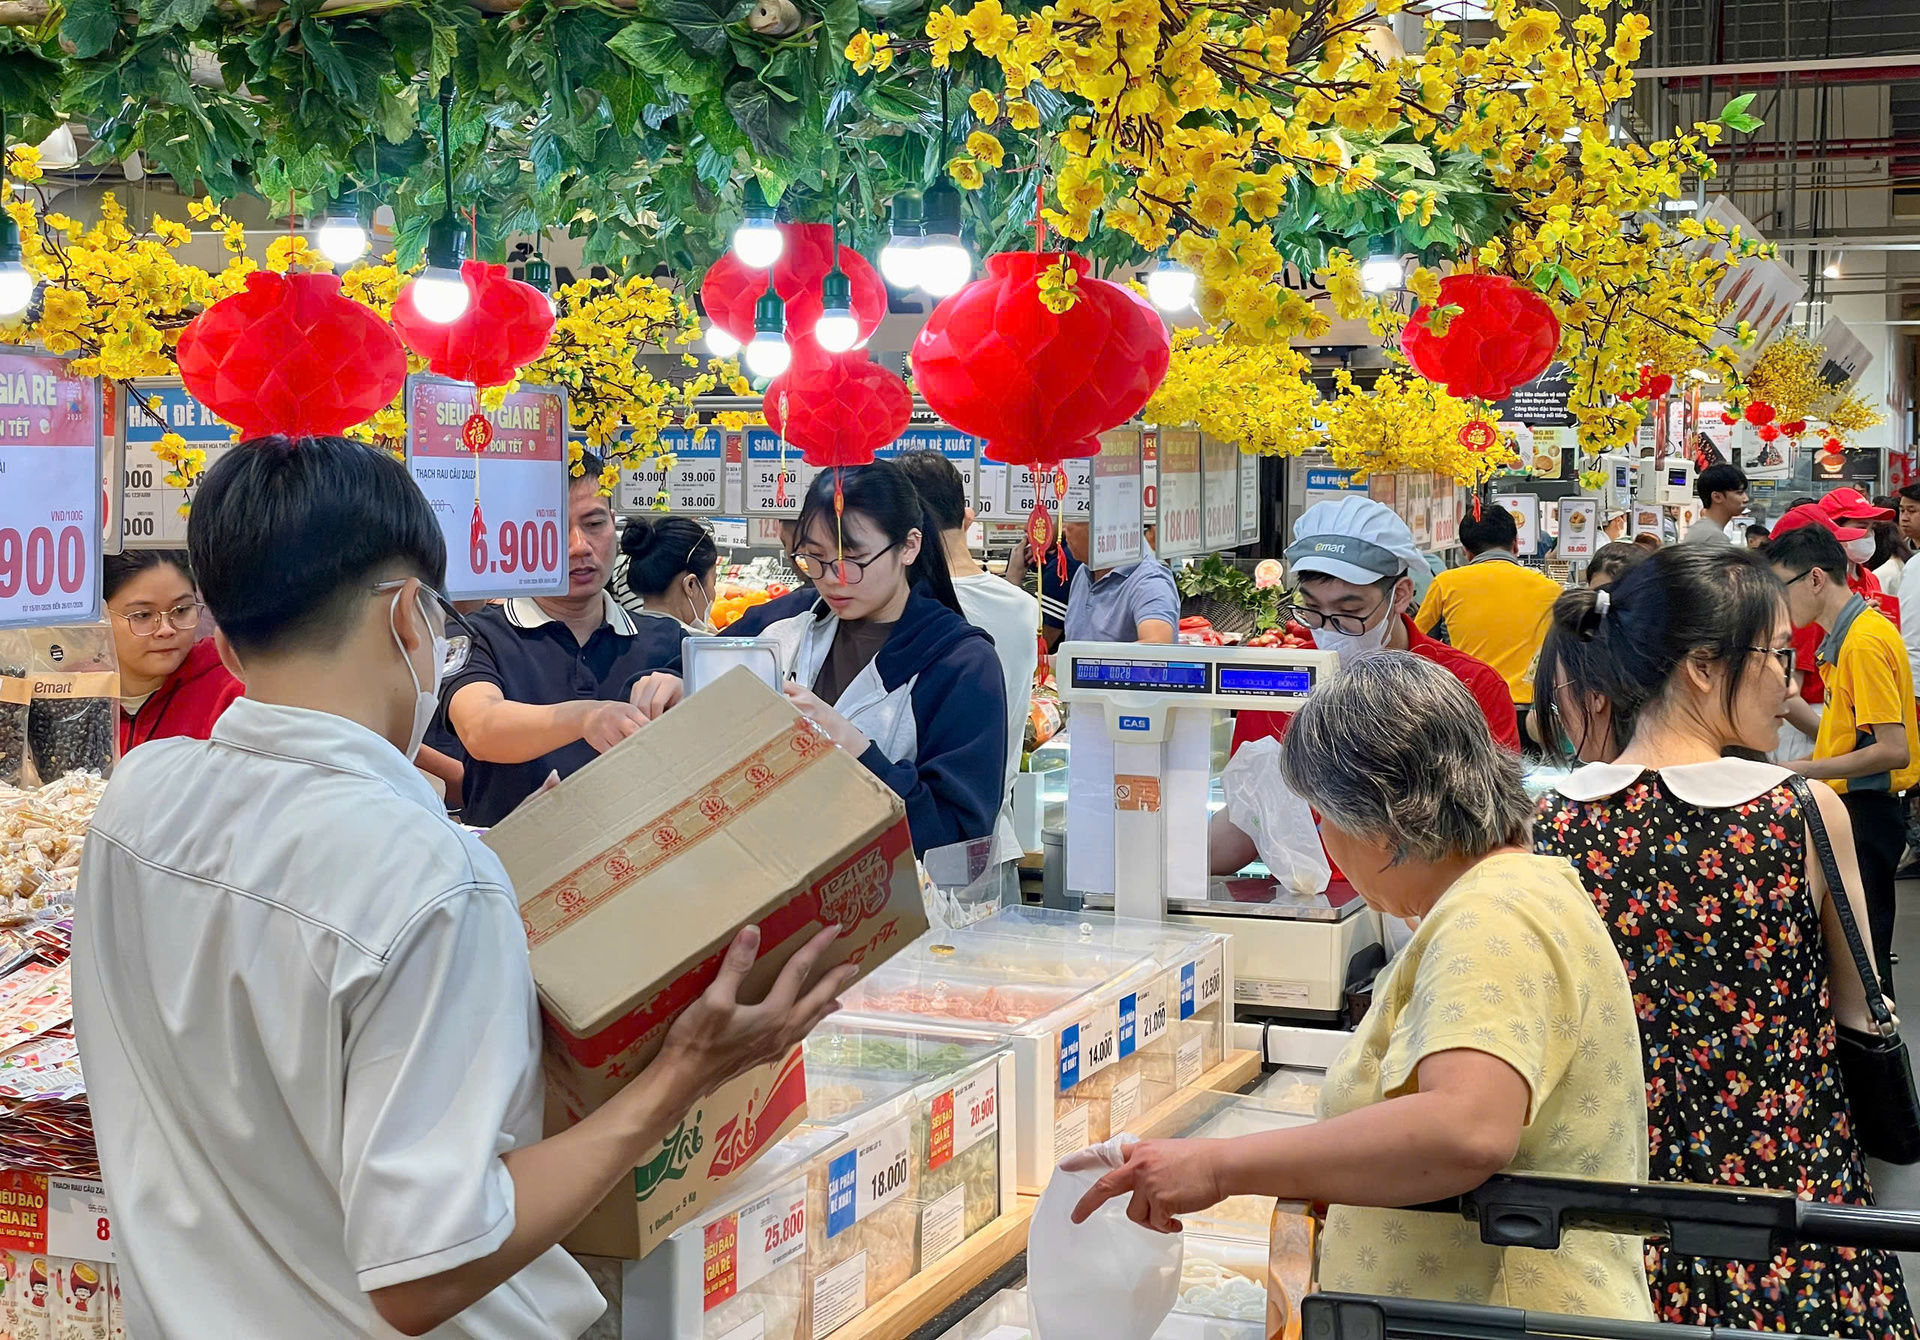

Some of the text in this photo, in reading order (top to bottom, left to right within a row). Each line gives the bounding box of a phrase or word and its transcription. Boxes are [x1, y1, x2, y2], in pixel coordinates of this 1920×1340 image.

[32, 370, 57, 406] RẺ
[436, 398, 466, 426] SIÊU
[497, 402, 522, 430] GIÁ
[8, 416, 30, 437] TẾT
[468, 422, 486, 445] 福
[754, 436, 774, 452] SẢN
[896, 435, 926, 451] PHẨM
[944, 435, 972, 452] XUẤT
[436, 469, 448, 480] RAU
[632, 472, 715, 482] 49.000 39.000
[682, 496, 715, 506] 38.000
[470, 520, 558, 574] 6.900
[1314, 542, 1346, 554] emart
[0, 525, 86, 598] 900
[34, 682, 72, 694] emart
[1123, 719, 1146, 728] CAS
[1144, 1007, 1166, 1037] 21.000
[1089, 1036, 1113, 1067] 14.000
[970, 1095, 994, 1128] 20.900
[872, 1158, 906, 1200] 18.000
[682, 1196, 688, 1208] 5
[764, 1209, 804, 1254] 25.800
